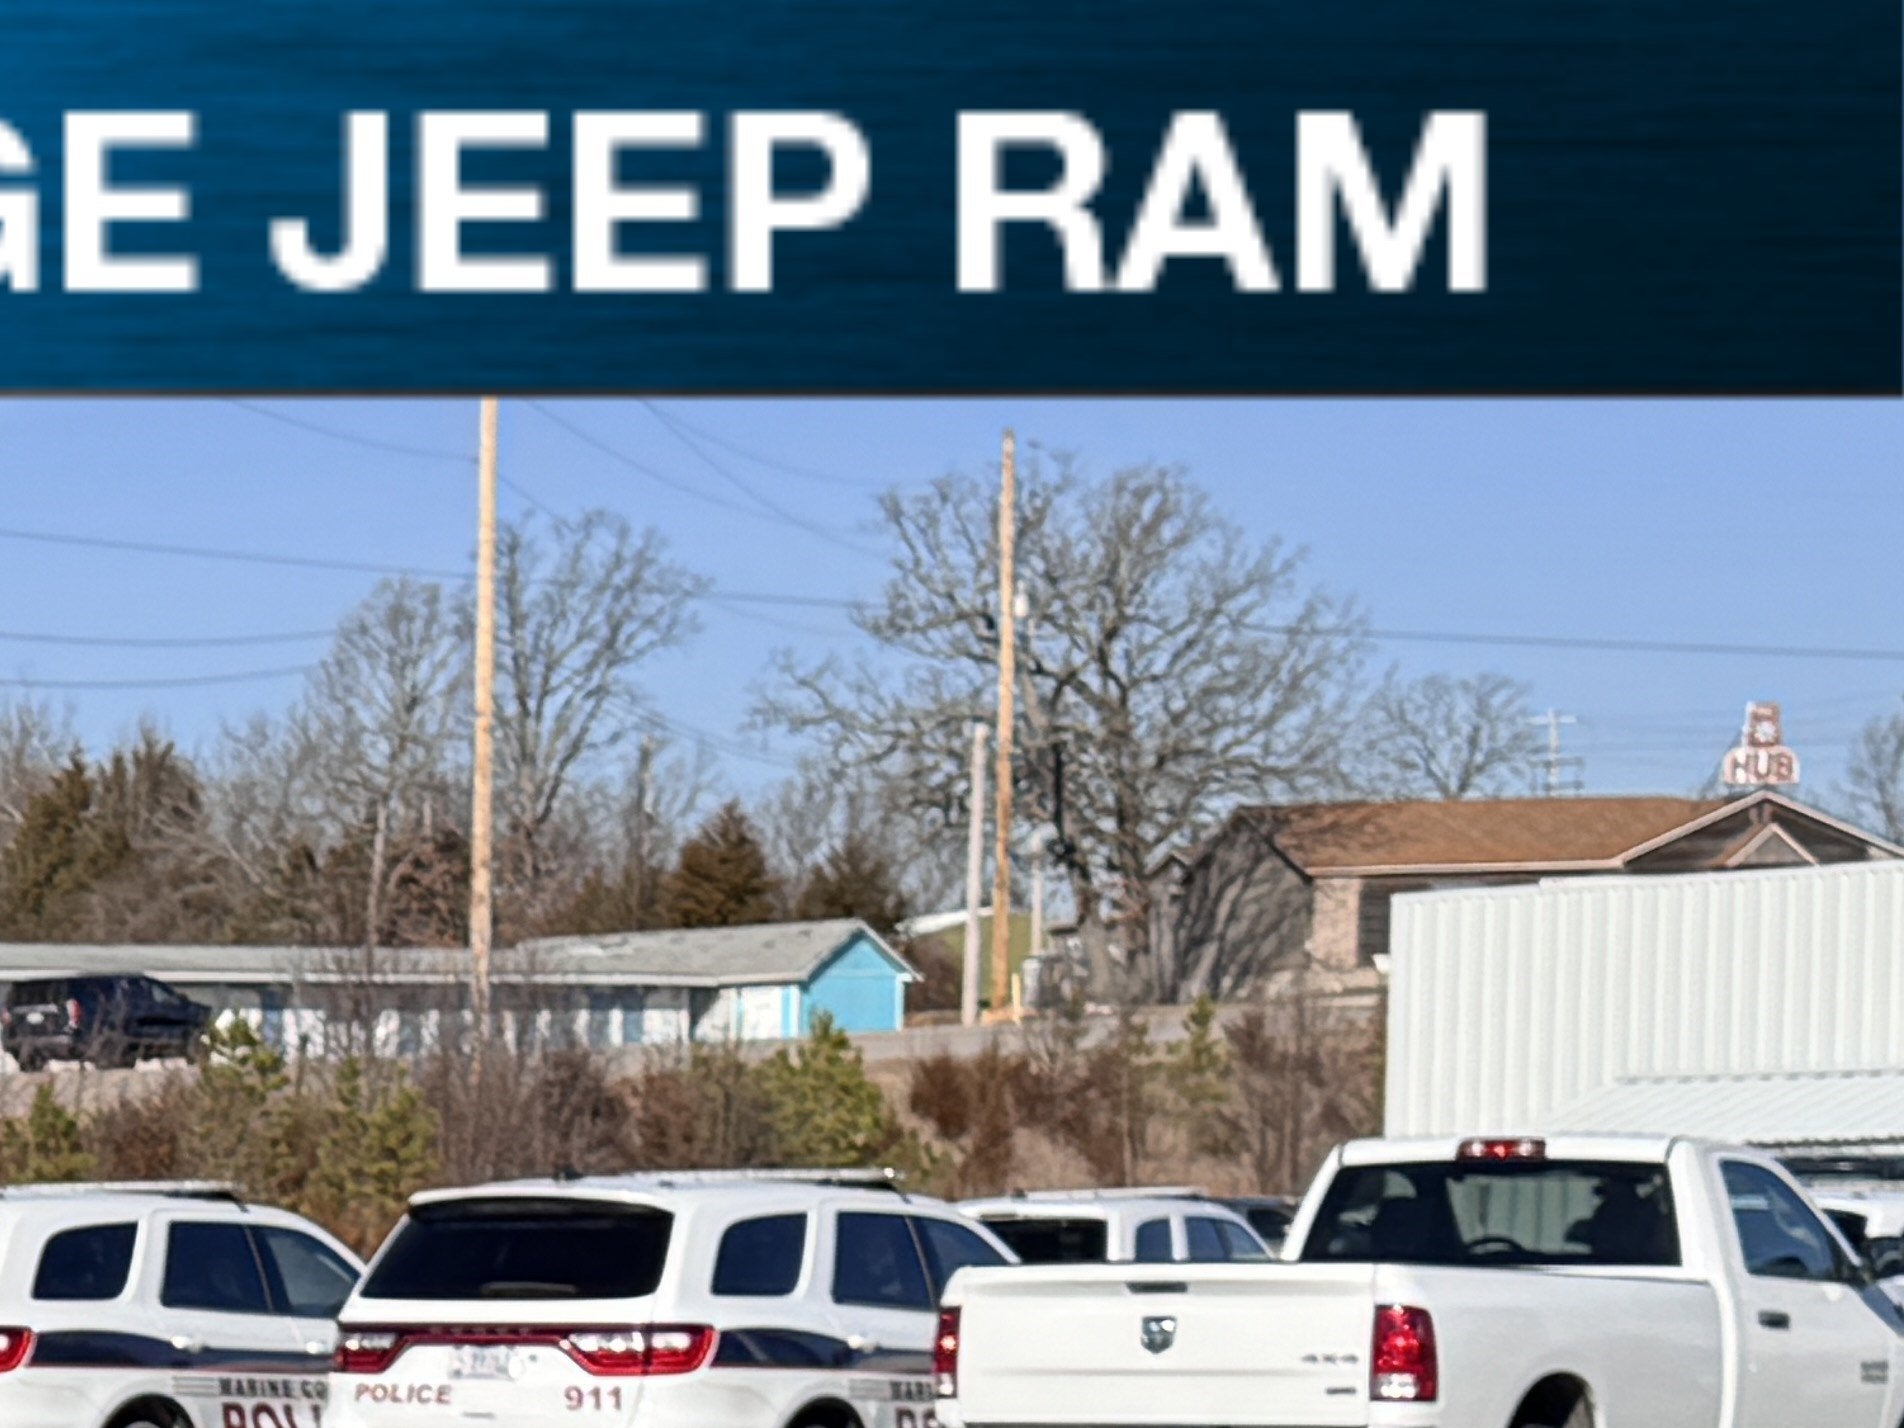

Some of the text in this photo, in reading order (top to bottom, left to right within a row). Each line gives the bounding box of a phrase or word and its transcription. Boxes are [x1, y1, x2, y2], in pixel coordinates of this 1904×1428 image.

[1730, 751, 1794, 781] HUB
[354, 1382, 454, 1405] POLICE
[563, 1385, 623, 1411] 911
